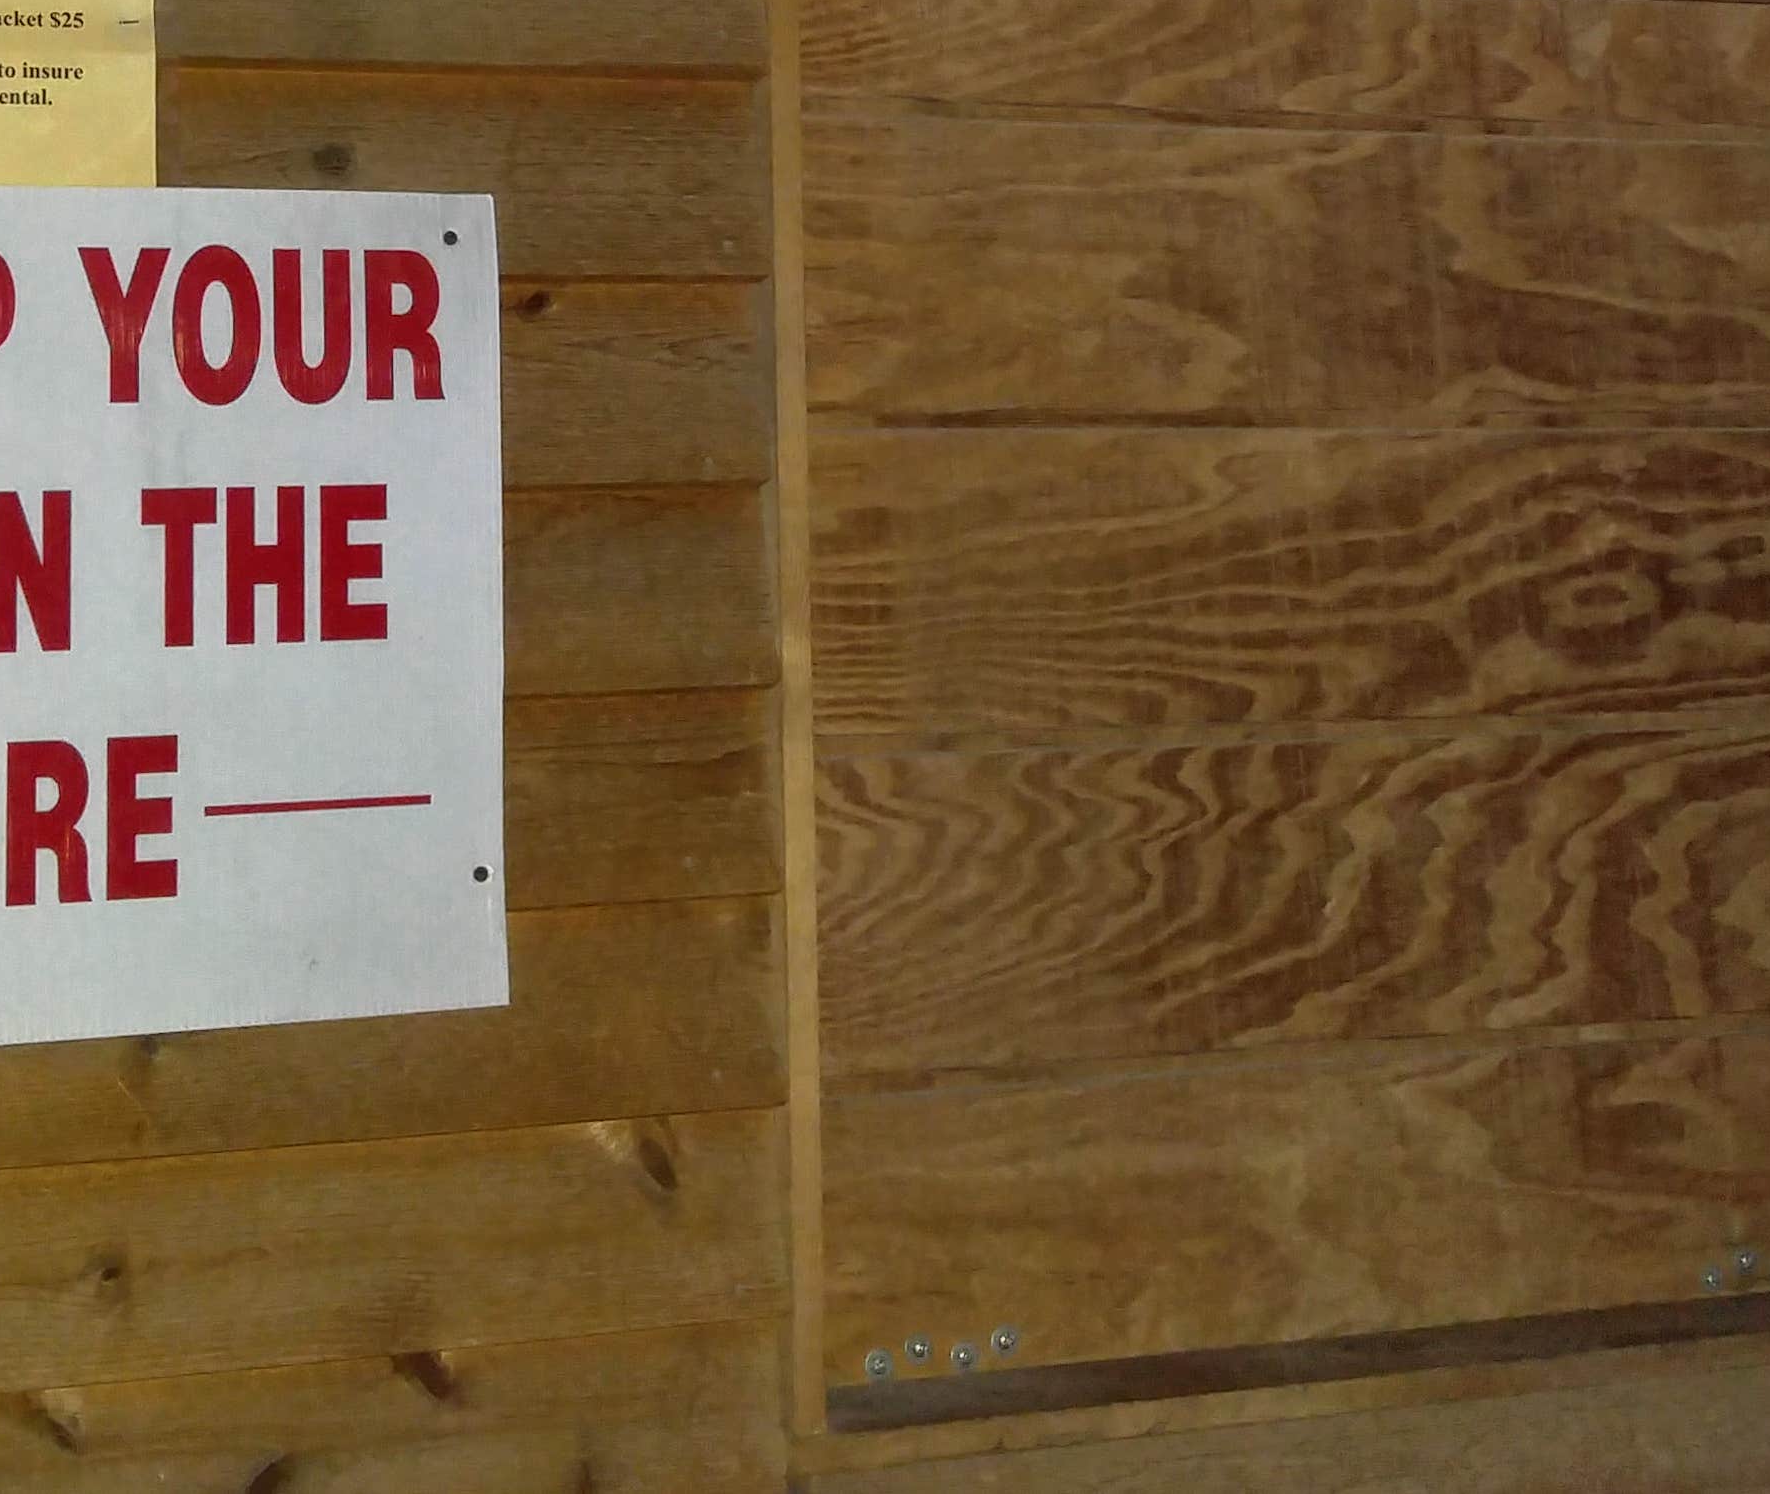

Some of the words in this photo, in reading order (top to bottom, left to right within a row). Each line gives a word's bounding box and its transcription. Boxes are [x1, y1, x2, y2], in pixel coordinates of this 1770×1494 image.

[50, 11, 84, 29] $25
[22, 62, 84, 80] insure
[77, 245, 446, 408] YOUR
[139, 483, 390, 649] THE
